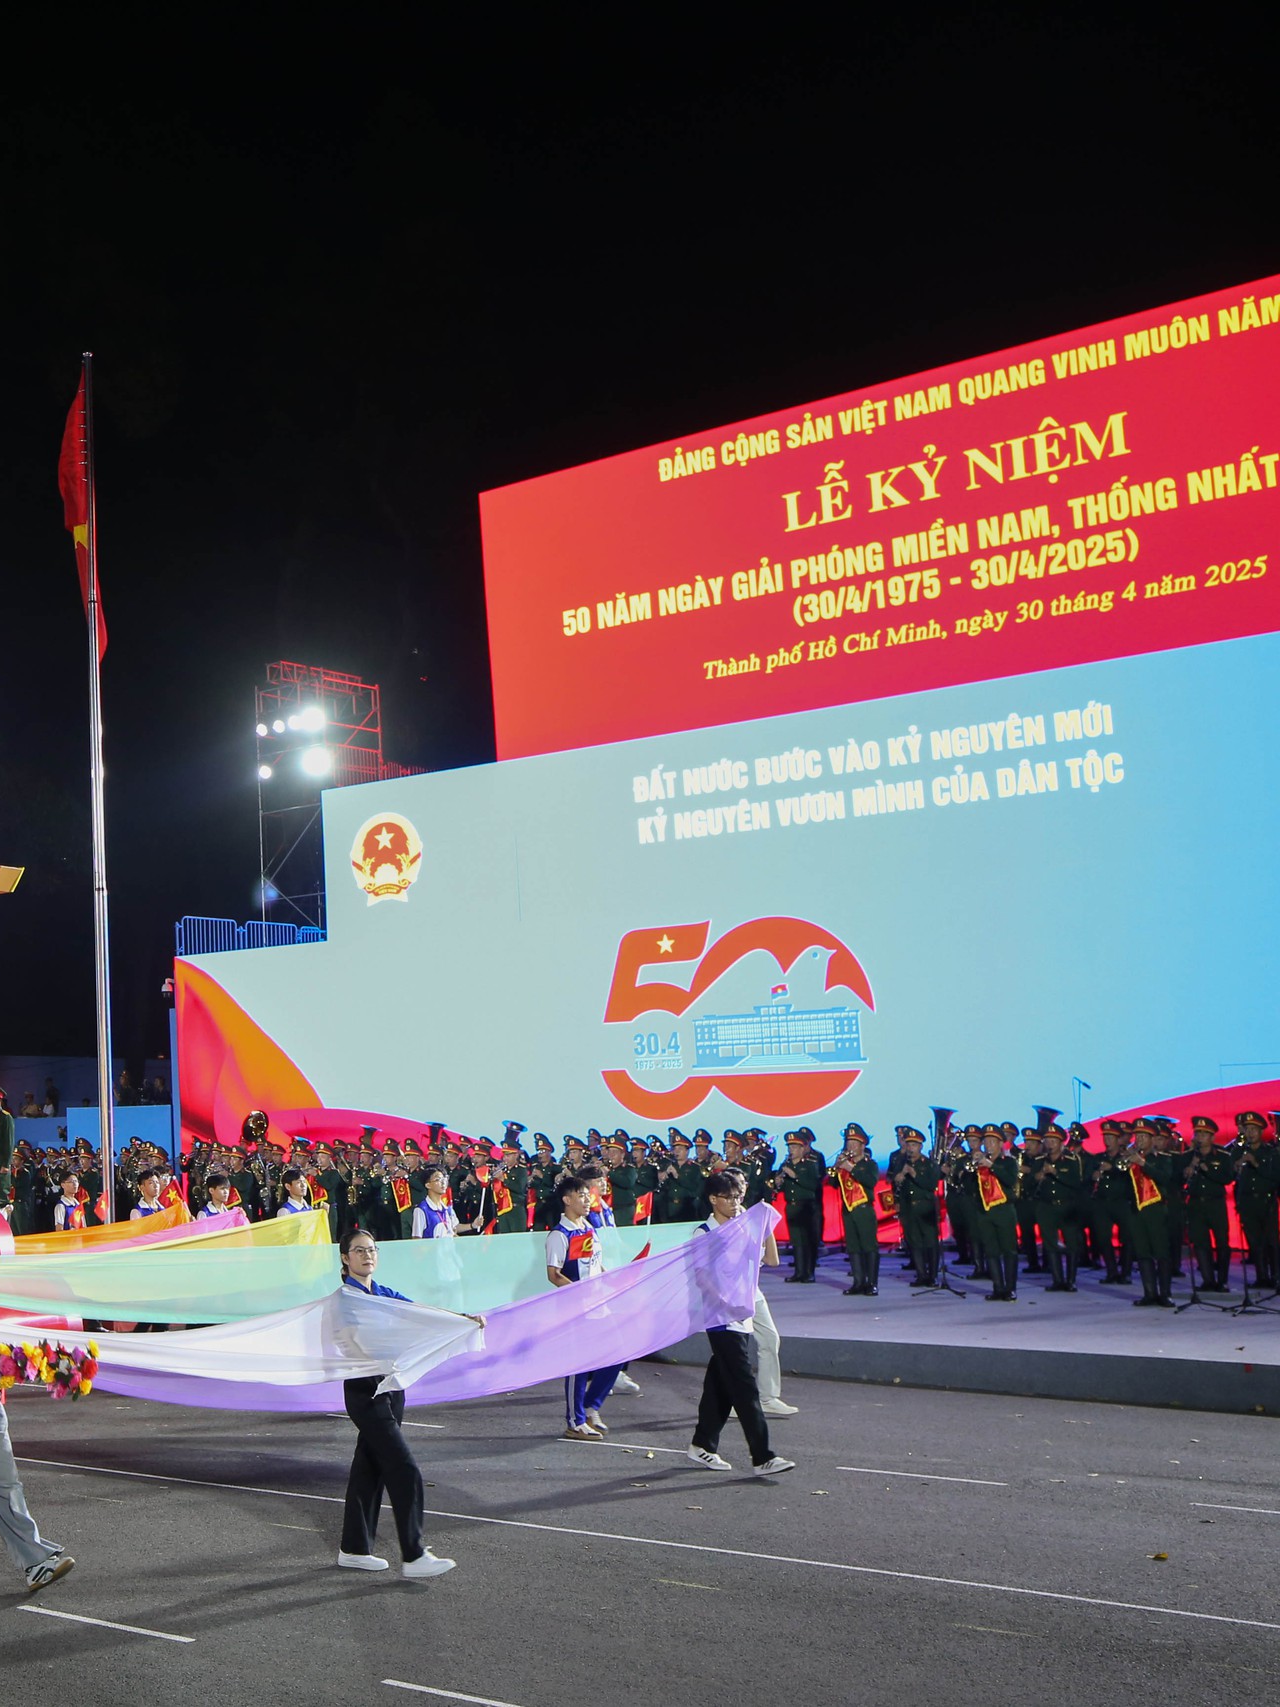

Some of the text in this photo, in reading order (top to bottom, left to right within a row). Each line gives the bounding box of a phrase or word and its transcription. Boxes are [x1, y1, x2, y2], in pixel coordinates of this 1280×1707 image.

[659, 294, 1280, 482] ĐẢNG CỘNG SẢN VIỆT NAM QUANG VINH MUÔN NĂM
[781, 411, 1131, 533] LỄ KỶ NIỆM
[562, 445, 1280, 637] 50 NĂM NGÀY GIẢI PHÓNG MIỀN NAM, THỐNG NHẤT
[793, 568, 941, 627] (30/4/1975
[970, 527, 1140, 590] 30/4/2025)
[703, 555, 1268, 680] Thành phố Hồ Chí Minh, ngày 30 tháng 4 năm 2025
[632, 700, 1114, 803] ĐẤT NƯỚC BƯỚC VÀO KỶ NGUYÊN MỚI
[638, 749, 1124, 844] KỶ NGUYÊN VƯƠN MÌNH CỦA DÂN TỘC
[633, 1031, 681, 1056] 30.4
[634, 1060, 654, 1070] 1975
[661, 1059, 683, 1069] 2025
